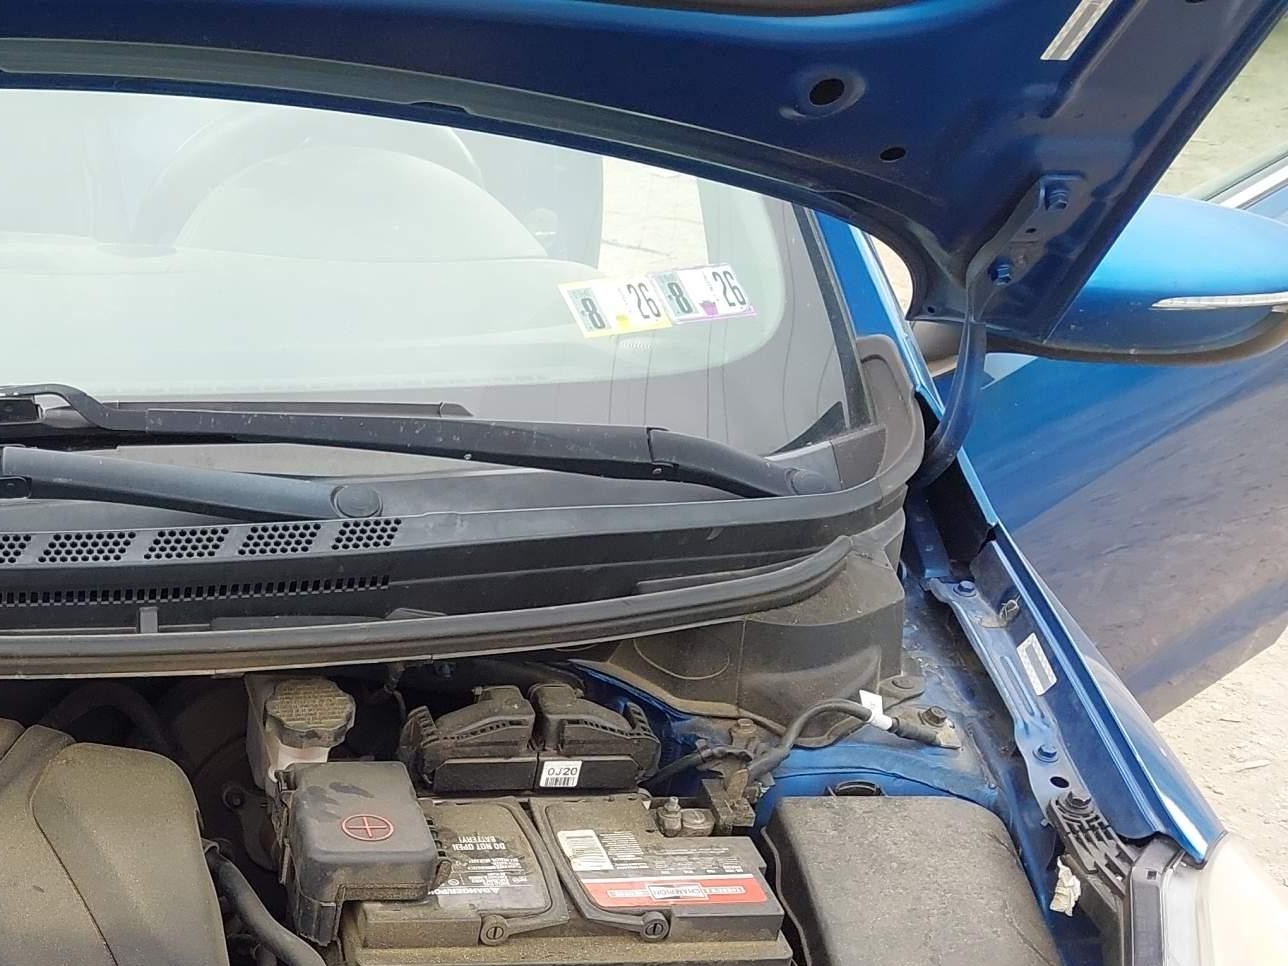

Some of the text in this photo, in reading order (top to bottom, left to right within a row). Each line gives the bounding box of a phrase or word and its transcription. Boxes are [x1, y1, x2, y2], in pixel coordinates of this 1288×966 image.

[581, 282, 662, 329] 8 26
[667, 270, 746, 314] 8 26
